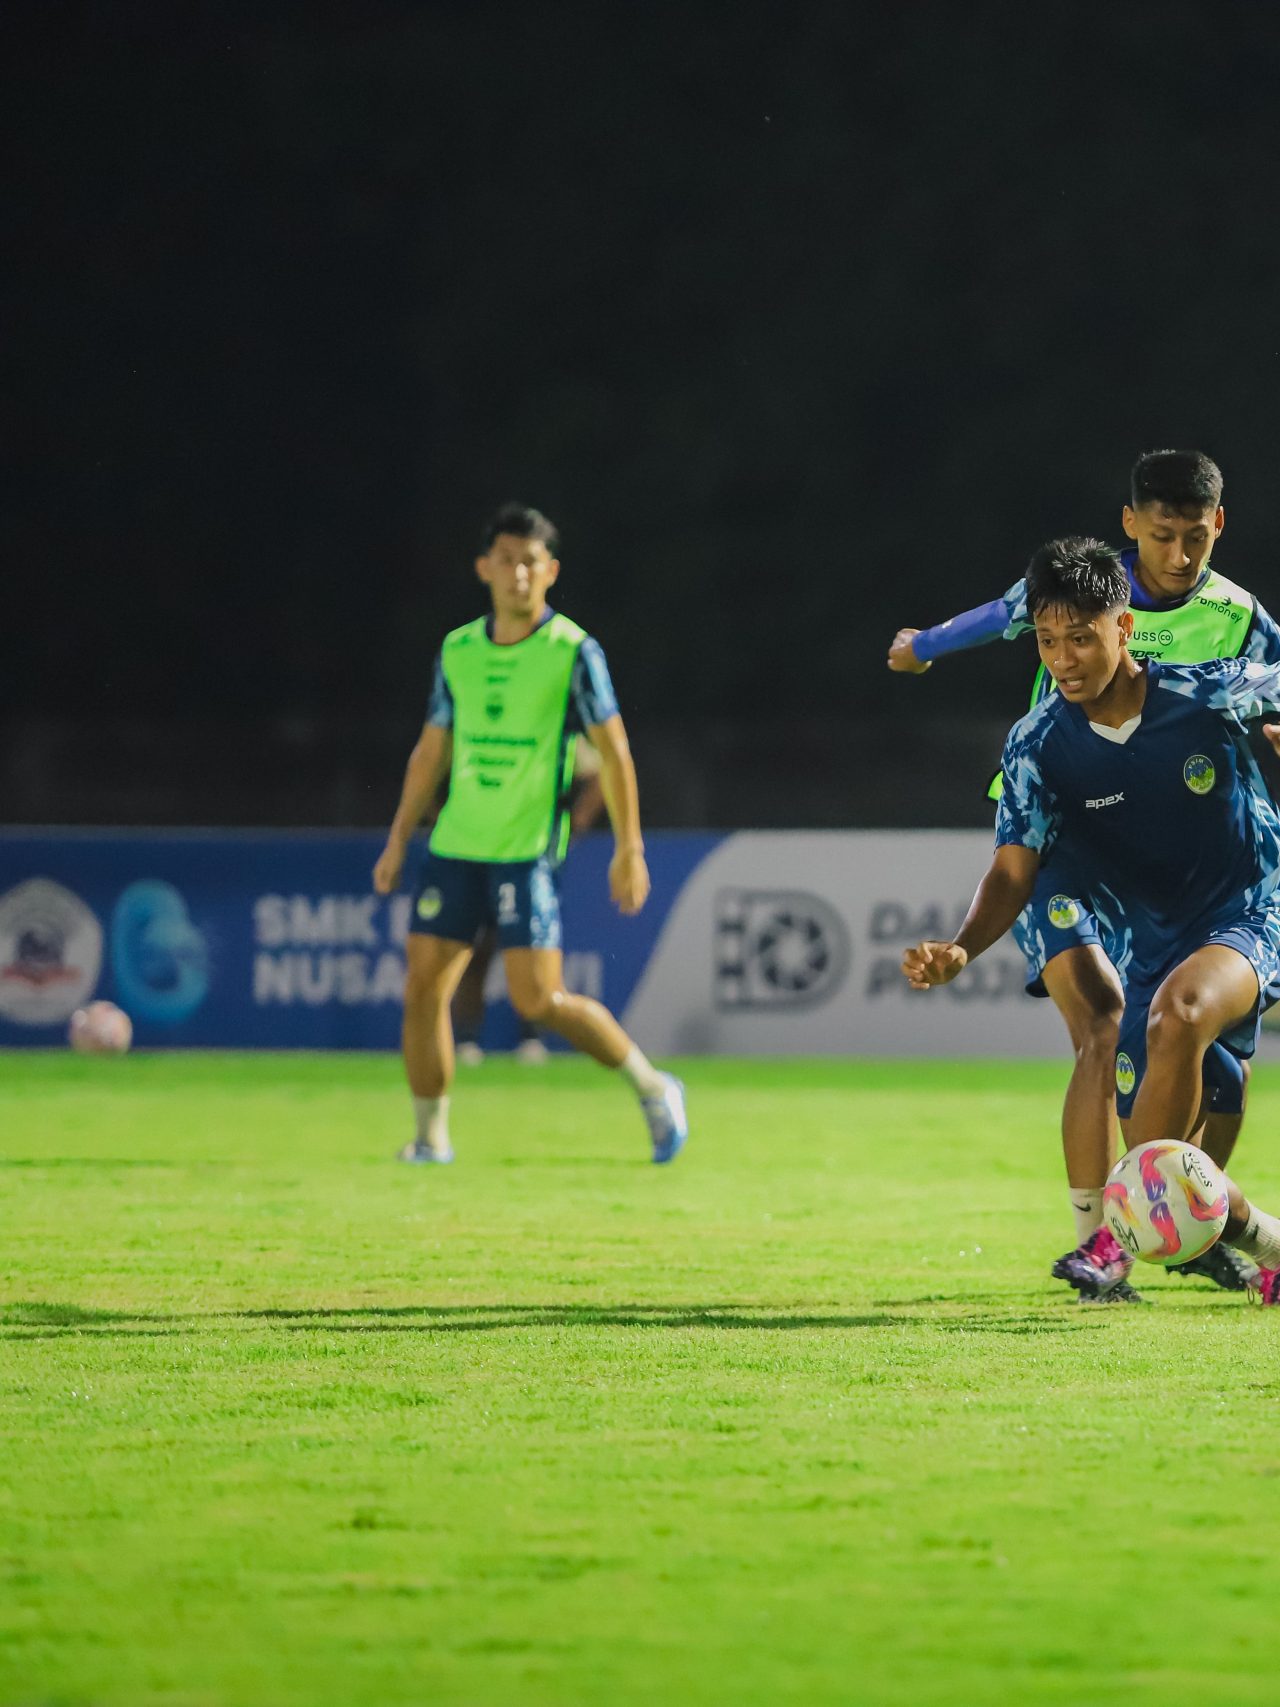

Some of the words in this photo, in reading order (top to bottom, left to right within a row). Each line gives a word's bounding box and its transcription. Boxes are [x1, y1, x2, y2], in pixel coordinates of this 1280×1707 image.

[1200, 597, 1243, 624] bmoney
[1133, 631, 1157, 642] USS
[1085, 791, 1125, 810] apex
[255, 893, 376, 946] SMK
